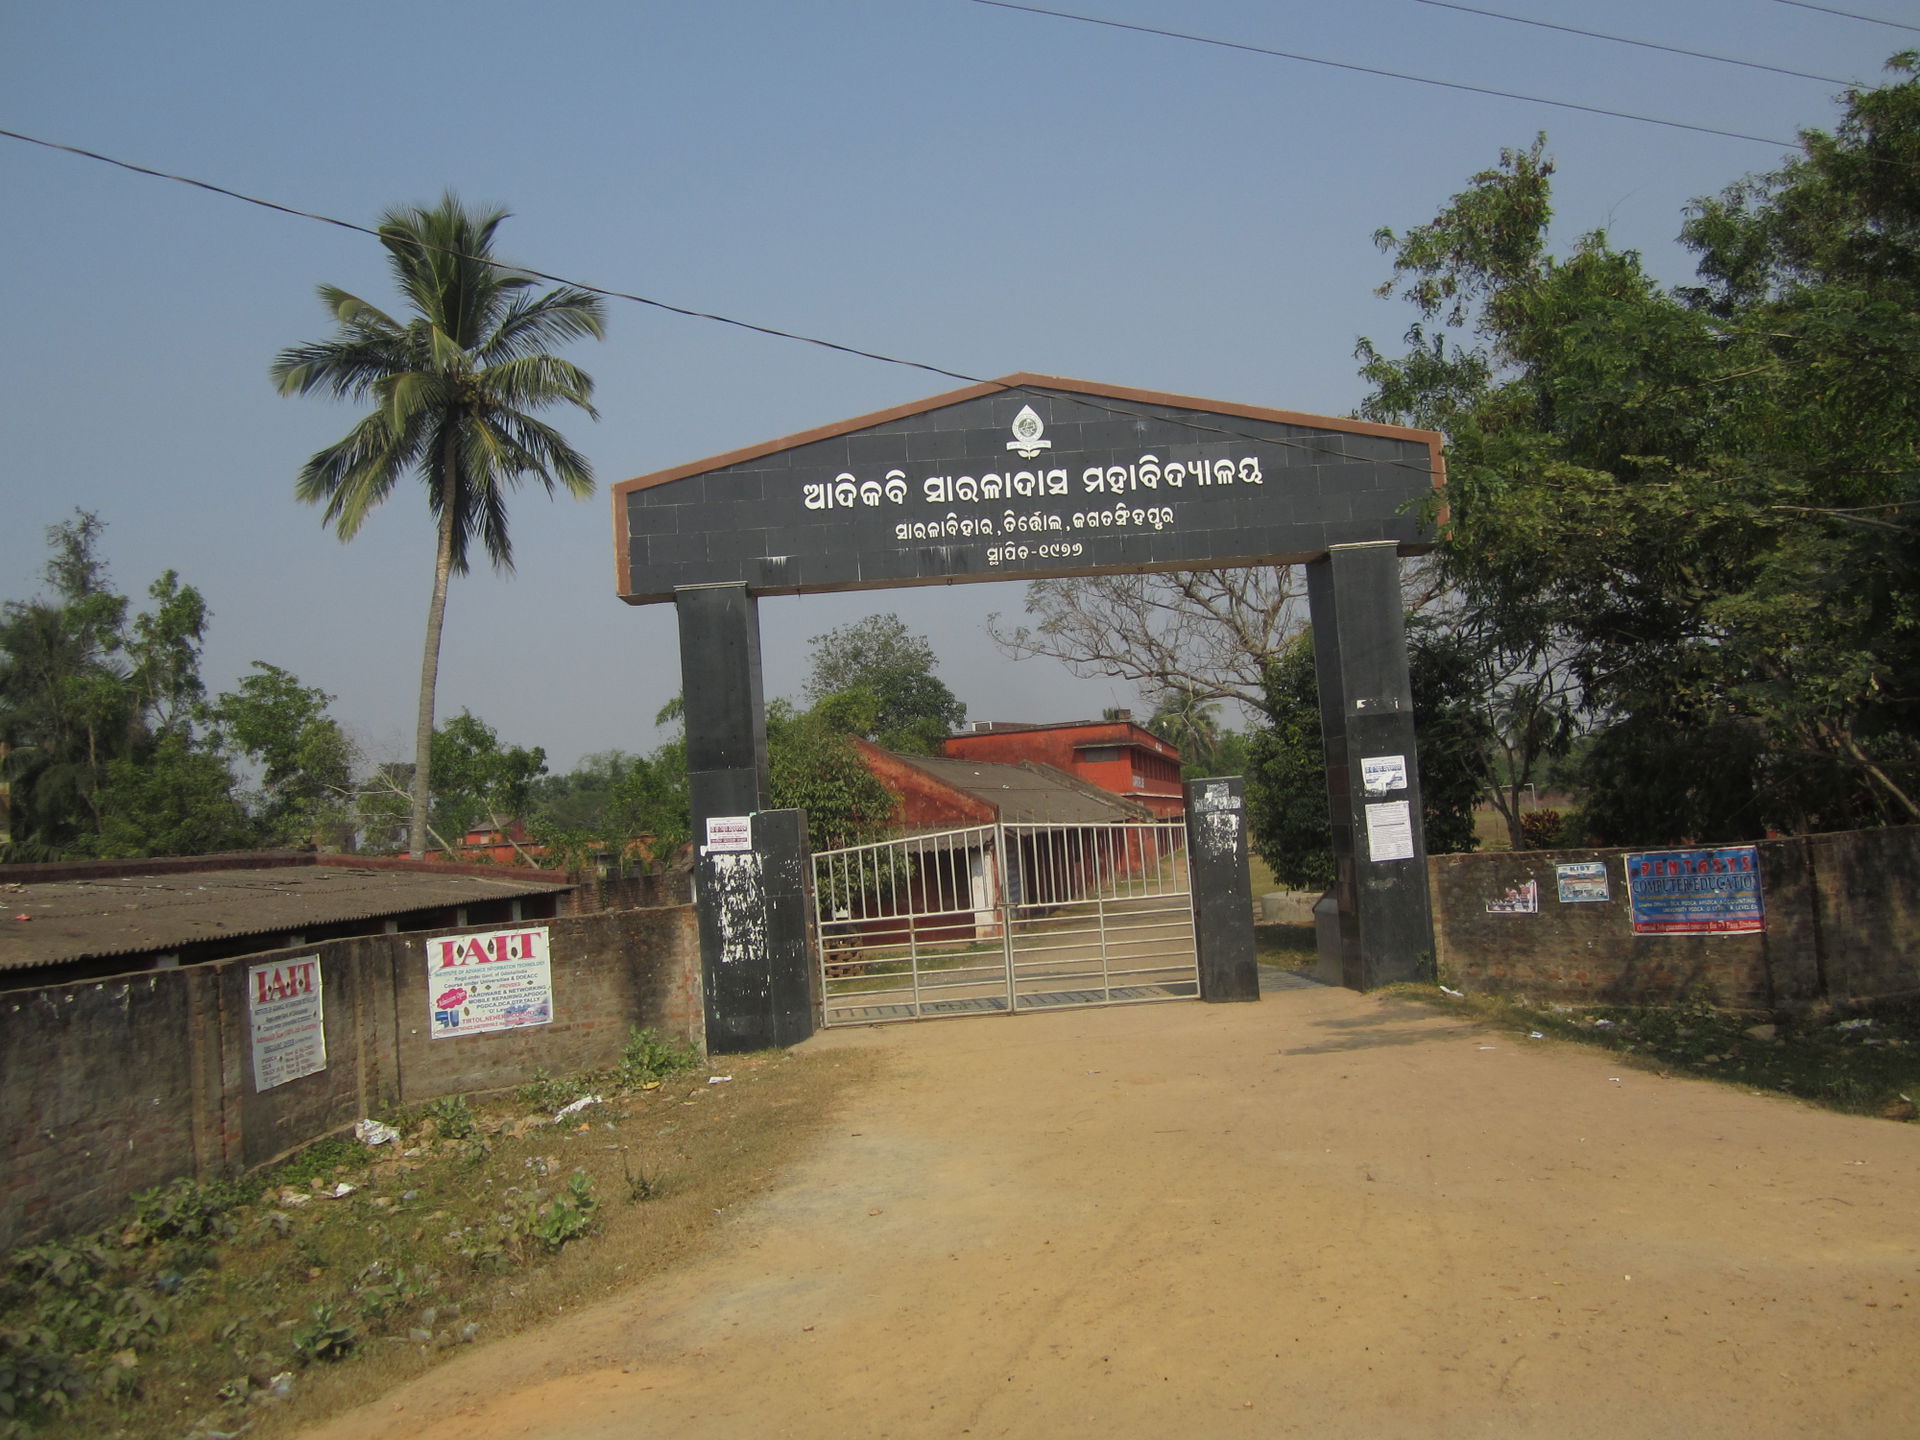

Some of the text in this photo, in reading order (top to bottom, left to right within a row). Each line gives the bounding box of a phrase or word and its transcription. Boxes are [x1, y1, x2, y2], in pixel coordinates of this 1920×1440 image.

[803, 454, 1263, 510] ଆଦିକବି ସାରଳାଦାସ ମହାବିଦ୍ୟାଳୟ
[1640, 856, 1752, 876] PENTASYS
[1632, 874, 1757, 894] COMPUTER EDUCATION
[438, 932, 542, 968] IAIT
[256, 962, 314, 1004] IAIT
[468, 990, 501, 998] HARDWARE
[508, 984, 545, 993] NETWORKING
